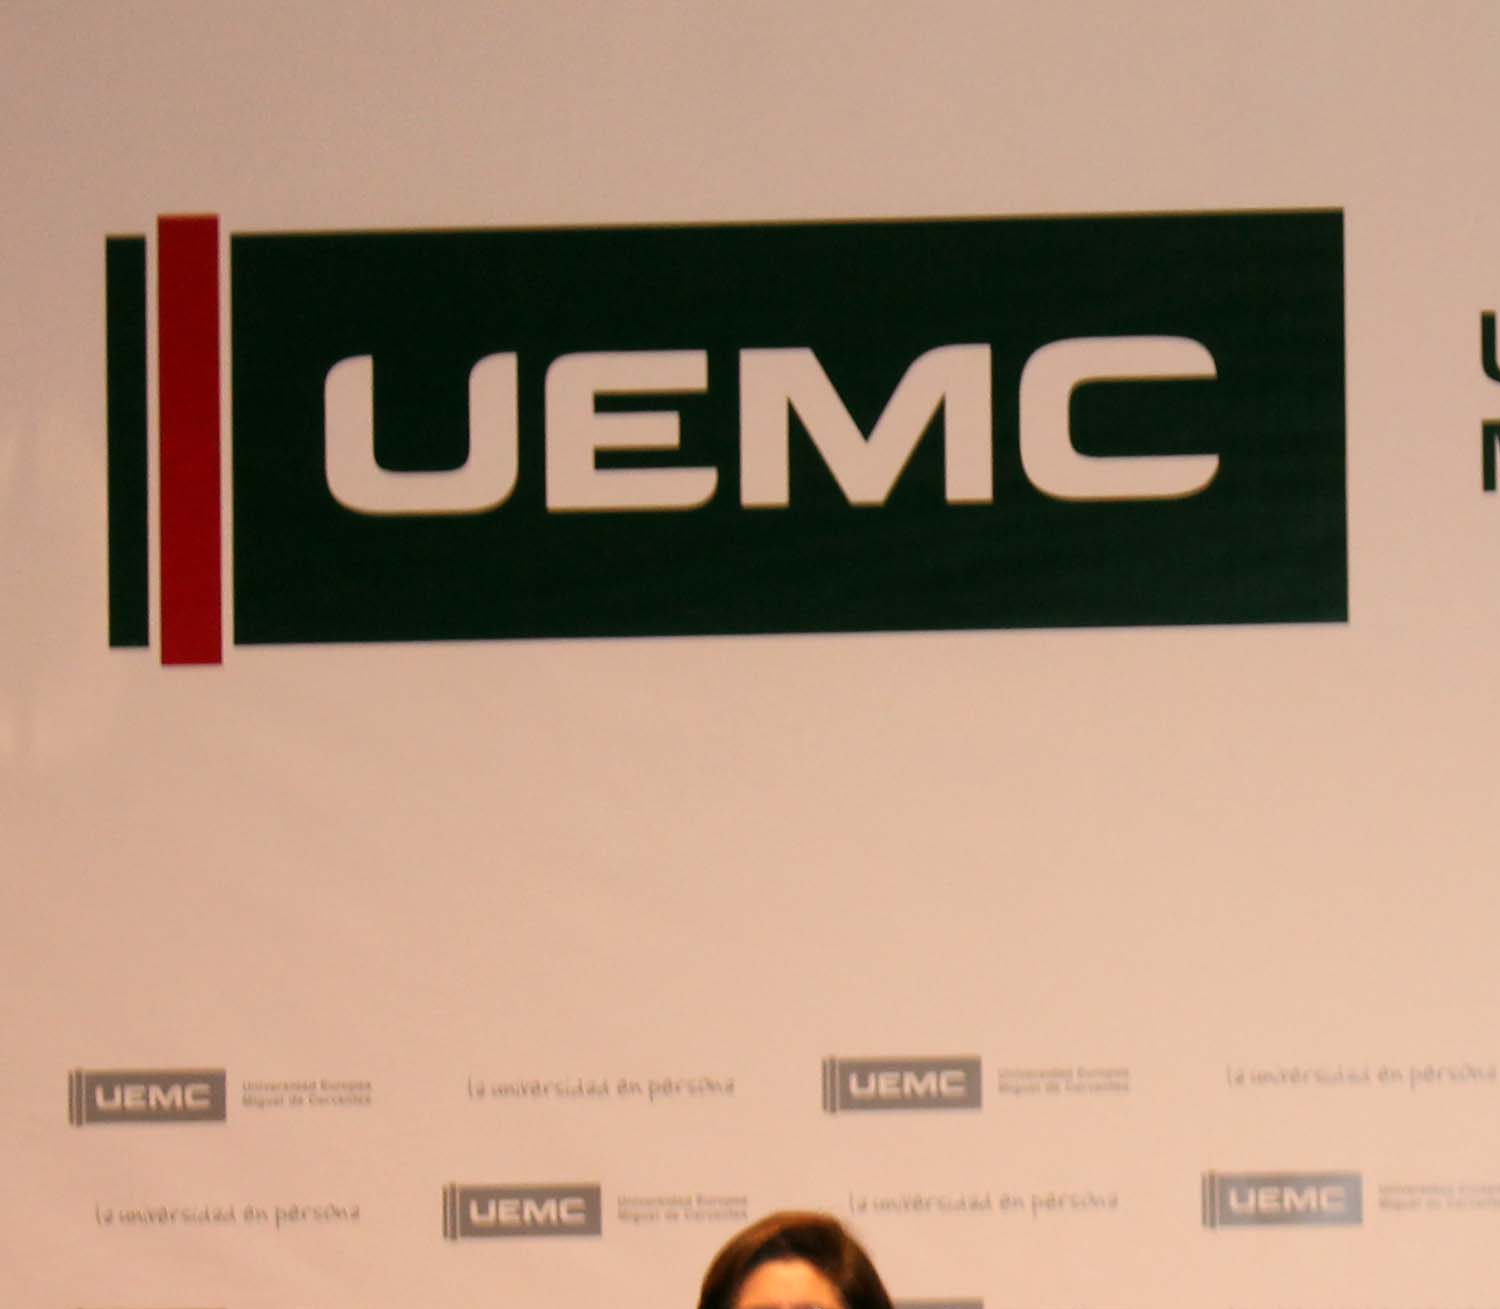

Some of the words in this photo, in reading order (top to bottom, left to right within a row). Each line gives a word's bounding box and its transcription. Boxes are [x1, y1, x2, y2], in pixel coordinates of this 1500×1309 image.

[324, 334, 1220, 516] UEMC
[95, 1083, 210, 1110] UEMC
[467, 1077, 486, 1100] la
[491, 1077, 610, 1099] universidad
[617, 1078, 643, 1098] en
[648, 1077, 736, 1104] persona
[849, 1070, 965, 1097] UEMC
[469, 1198, 585, 1225] UEMC
[1229, 1185, 1347, 1214] UEMC
[95, 1203, 114, 1227] la
[119, 1204, 237, 1226] universidad
[243, 1204, 269, 1224] en
[275, 1203, 361, 1231] persona
